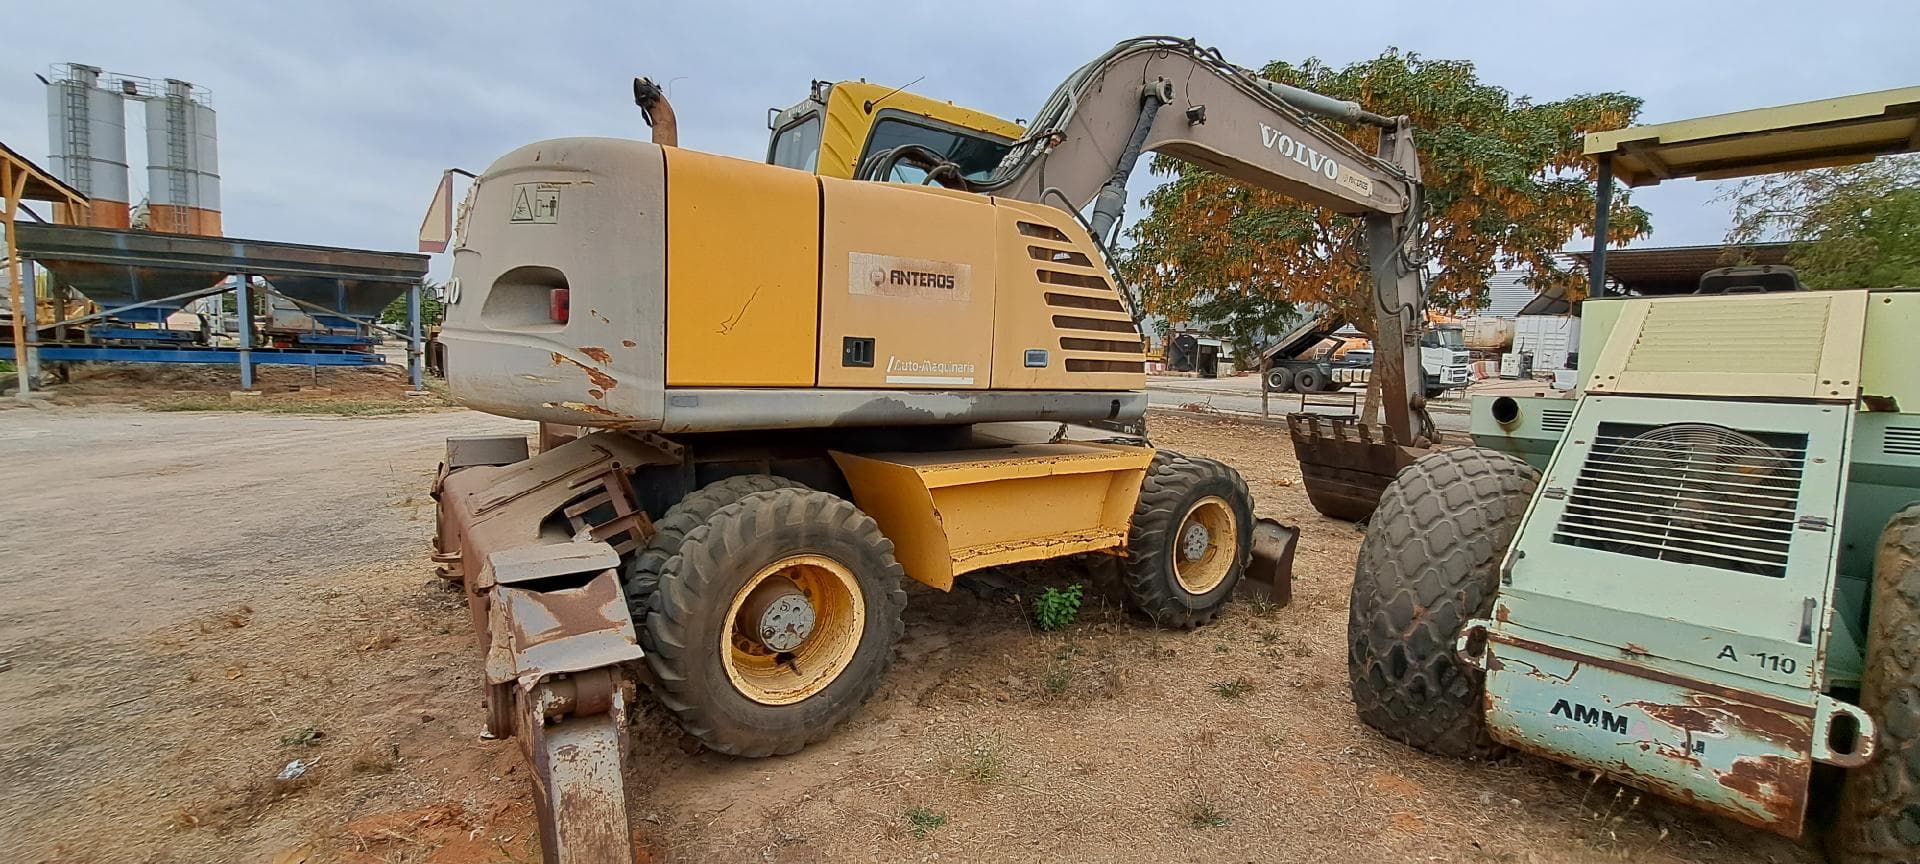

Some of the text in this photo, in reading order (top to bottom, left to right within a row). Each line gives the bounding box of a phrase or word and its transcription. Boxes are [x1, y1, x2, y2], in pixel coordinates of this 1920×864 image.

[1259, 122, 1338, 180] VOLVO
[890, 269, 955, 290] ANTEROS
[1756, 652, 1797, 675] 110
